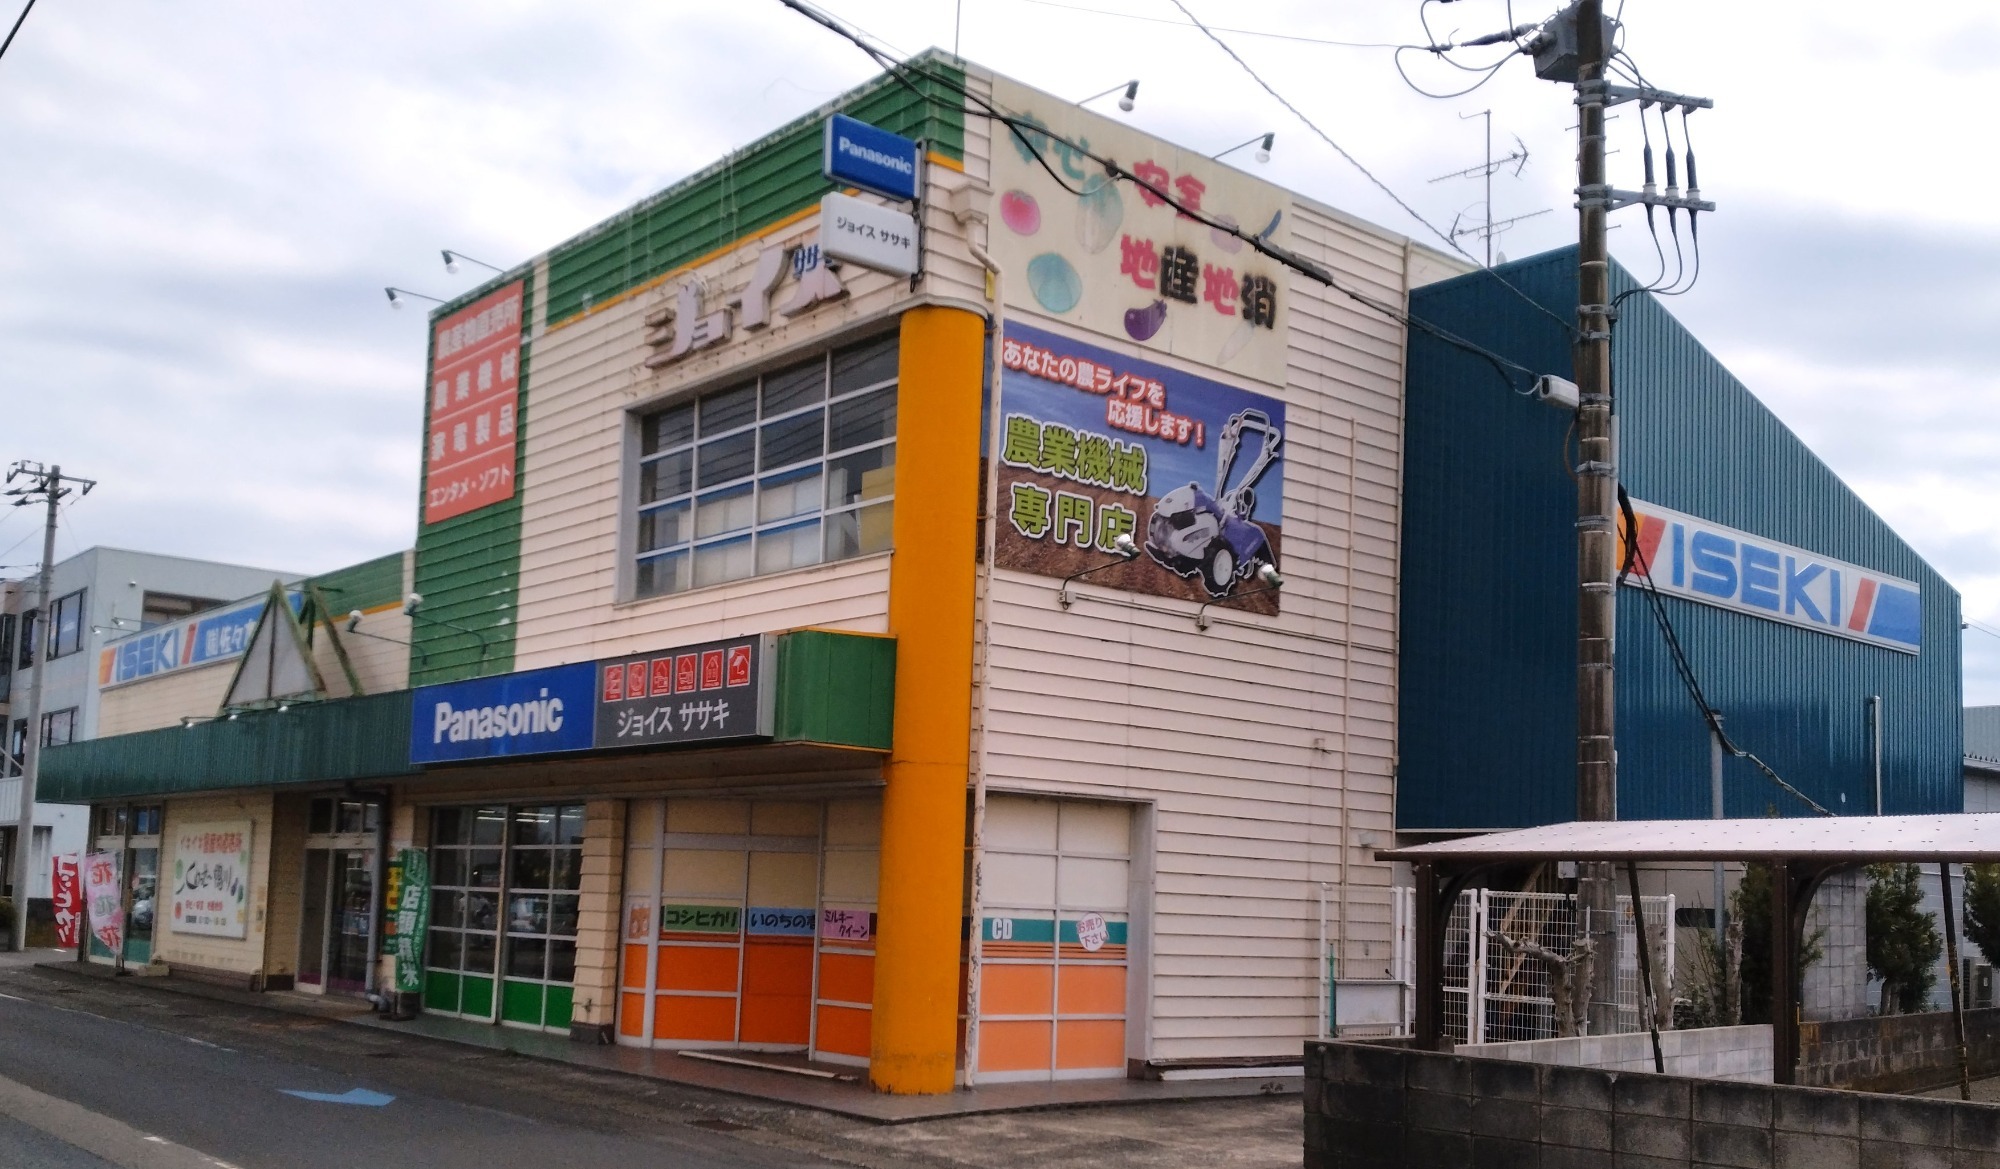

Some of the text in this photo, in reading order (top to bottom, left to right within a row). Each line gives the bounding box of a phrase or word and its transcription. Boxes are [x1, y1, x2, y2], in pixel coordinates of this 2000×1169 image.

[838, 135, 912, 175] Panasonic
[836, 215, 911, 250] ジョイス ササキ
[1120, 233, 1277, 330] 地産地消
[1003, 340, 1165, 407] あなたの農ライフを
[432, 403, 514, 461] 家電製品
[1107, 400, 1204, 445] 応援します！
[1004, 416, 1145, 492] 農業機械
[430, 464, 510, 507] エンタメ・ソフト
[1012, 485, 1134, 551] 専門店
[1672, 522, 1841, 627] ISEKI
[116, 627, 179, 683] ISEKI
[434, 688, 564, 743] Panasonic
[617, 698, 731, 738] ジョイス ササキ
[666, 909, 737, 927] コシヒカリ
[824, 909, 854, 924] ミルキー
[839, 924, 868, 938] クイーン
[992, 917, 1013, 940] CD
[1081, 930, 1109, 947] 下さい
